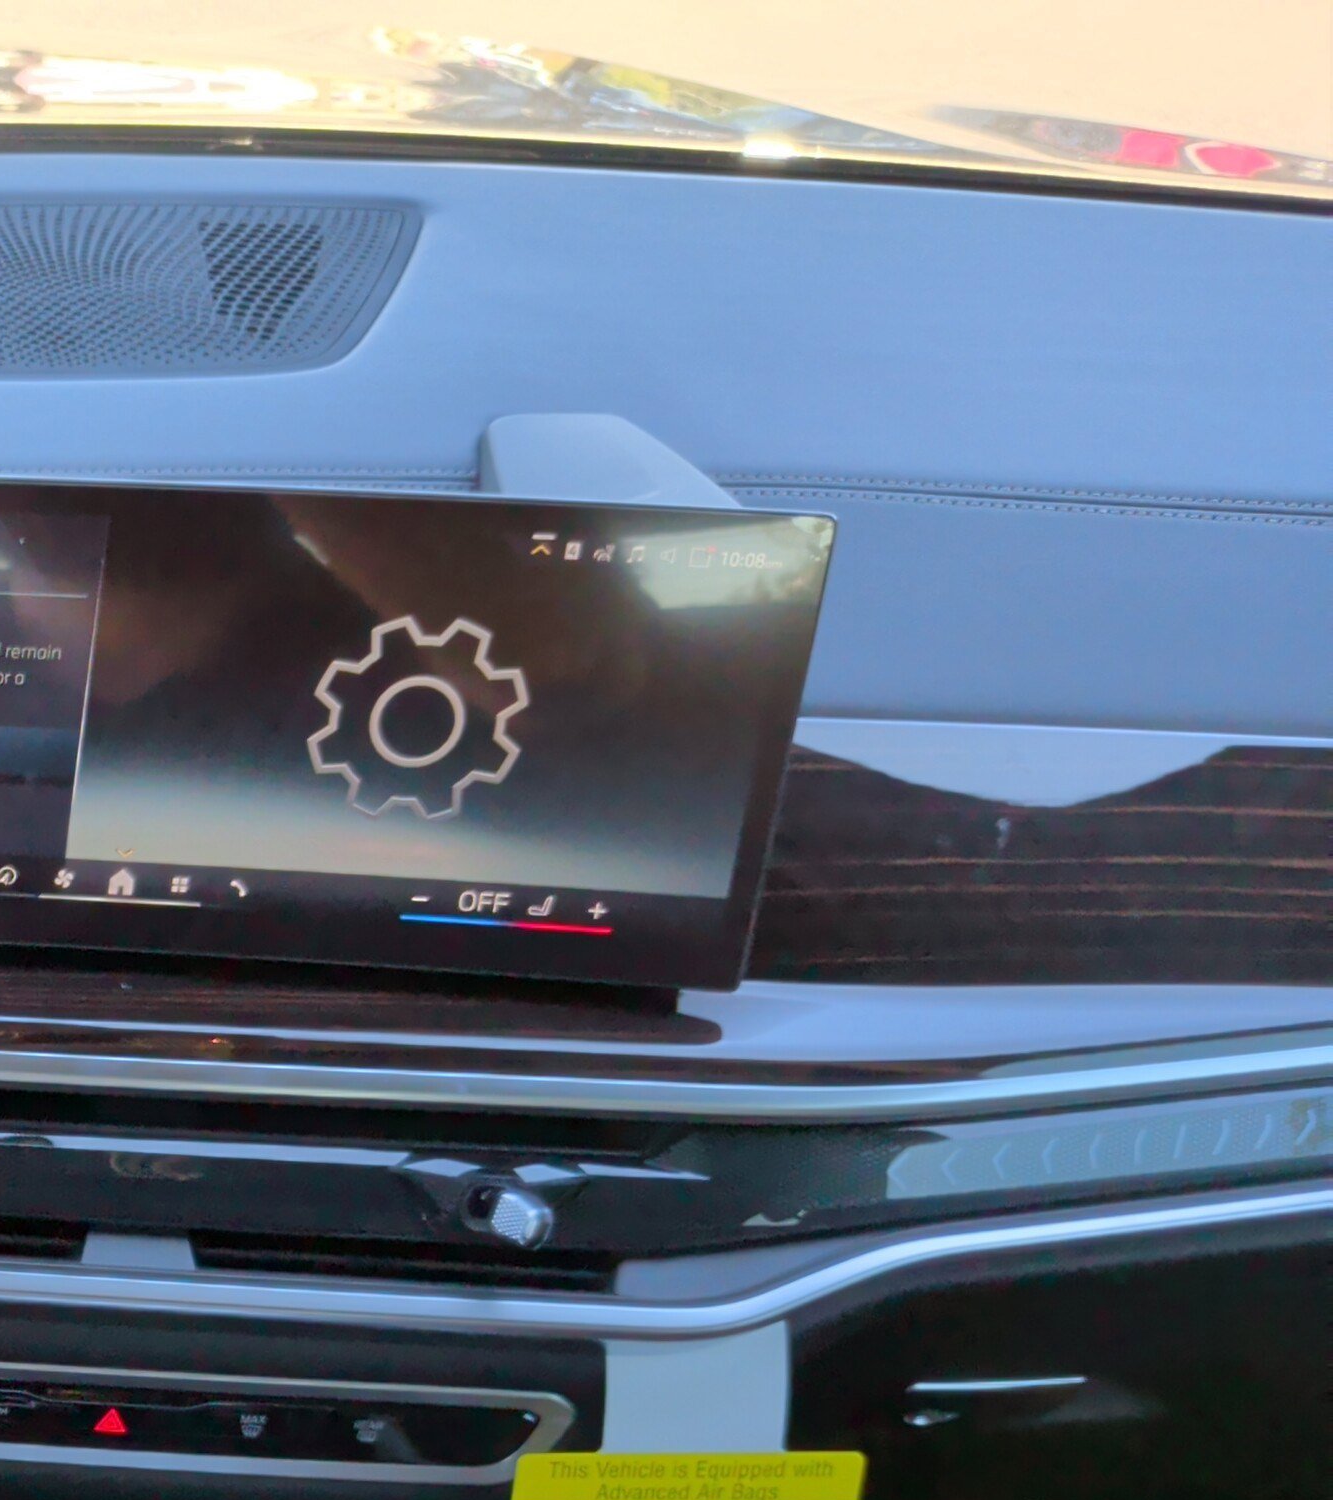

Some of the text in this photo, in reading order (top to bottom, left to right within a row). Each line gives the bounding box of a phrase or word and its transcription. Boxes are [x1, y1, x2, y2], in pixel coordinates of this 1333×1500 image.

[5, 644, 62, 661] remain
[14, 673, 25, 686] a
[458, 890, 511, 913] OFF
[550, 1460, 834, 1482] This Vehicle is Equipped with
[595, 1483, 689, 1500] Advanced
[696, 1484, 724, 1500] Air
